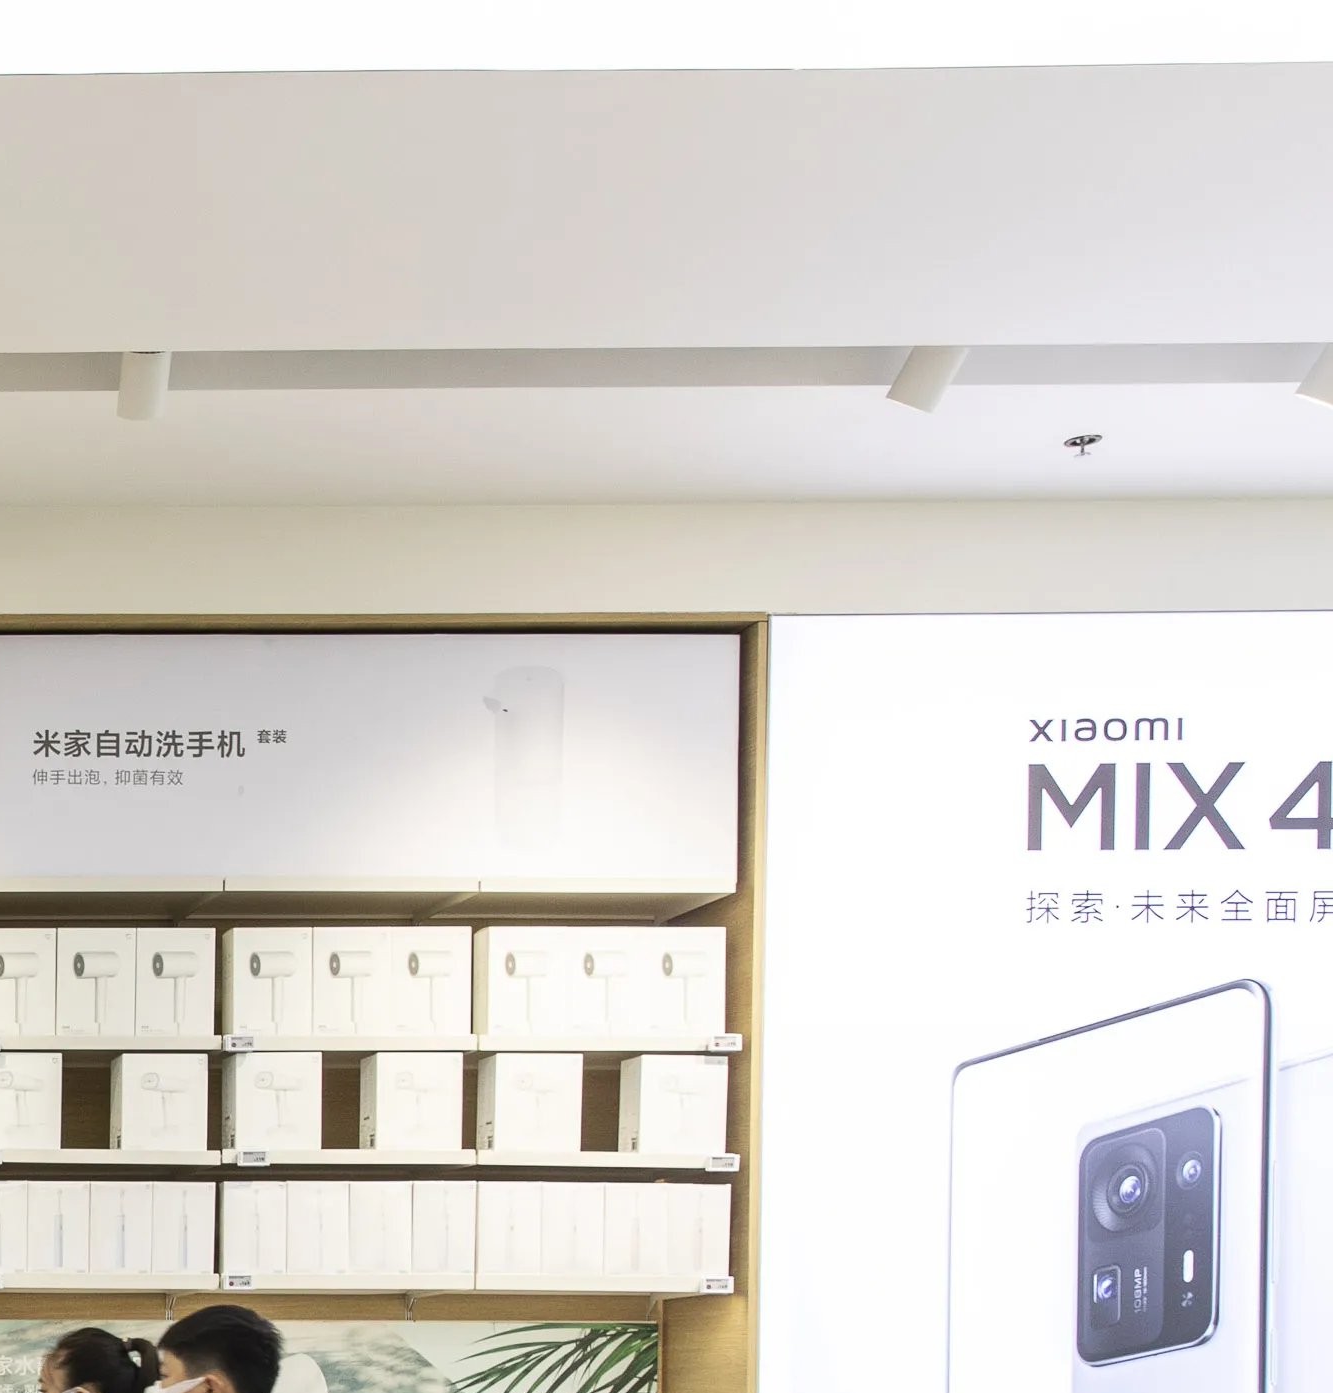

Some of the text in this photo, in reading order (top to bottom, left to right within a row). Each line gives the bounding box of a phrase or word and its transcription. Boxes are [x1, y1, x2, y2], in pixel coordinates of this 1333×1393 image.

[32, 729, 287, 759] 米家自动洗手机 套装
[1026, 761, 1333, 851] MIX 4
